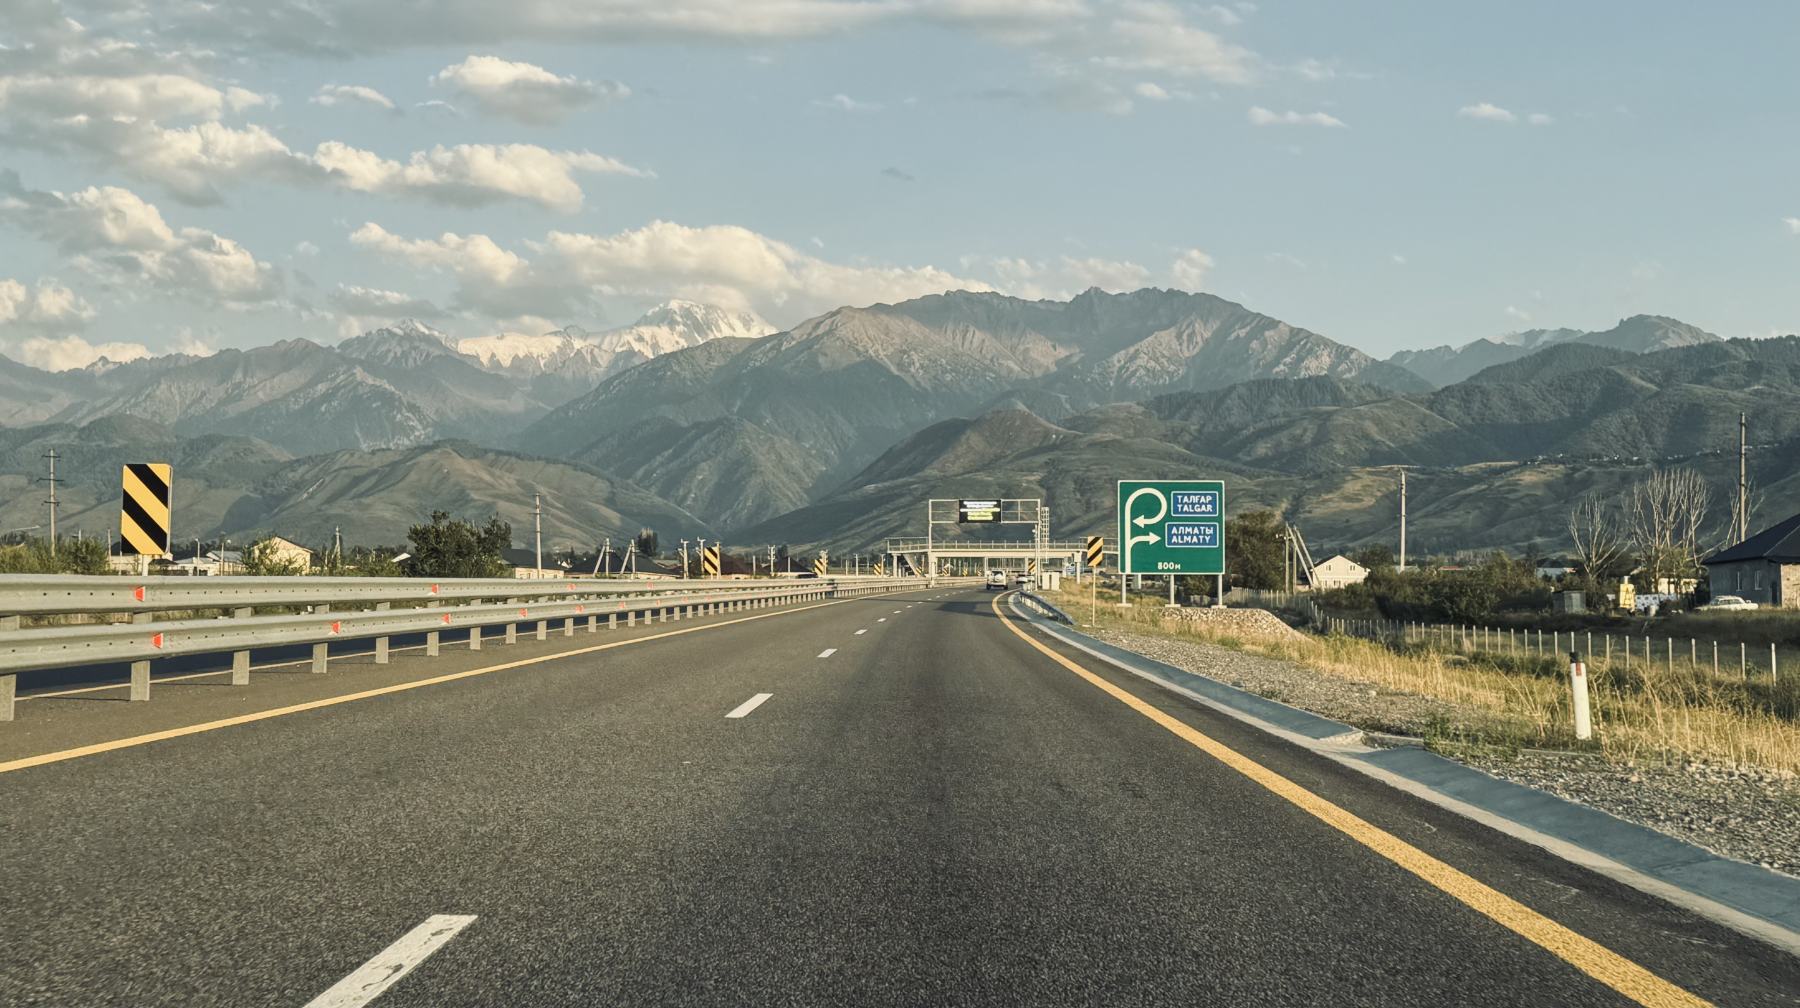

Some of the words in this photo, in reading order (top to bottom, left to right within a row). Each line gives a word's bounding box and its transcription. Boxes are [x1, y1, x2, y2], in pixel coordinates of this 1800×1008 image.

[1177, 504, 1213, 512] TALGAR
[1171, 526, 1213, 534] АЛМАТЫ
[1171, 535, 1211, 544] ALMATY
